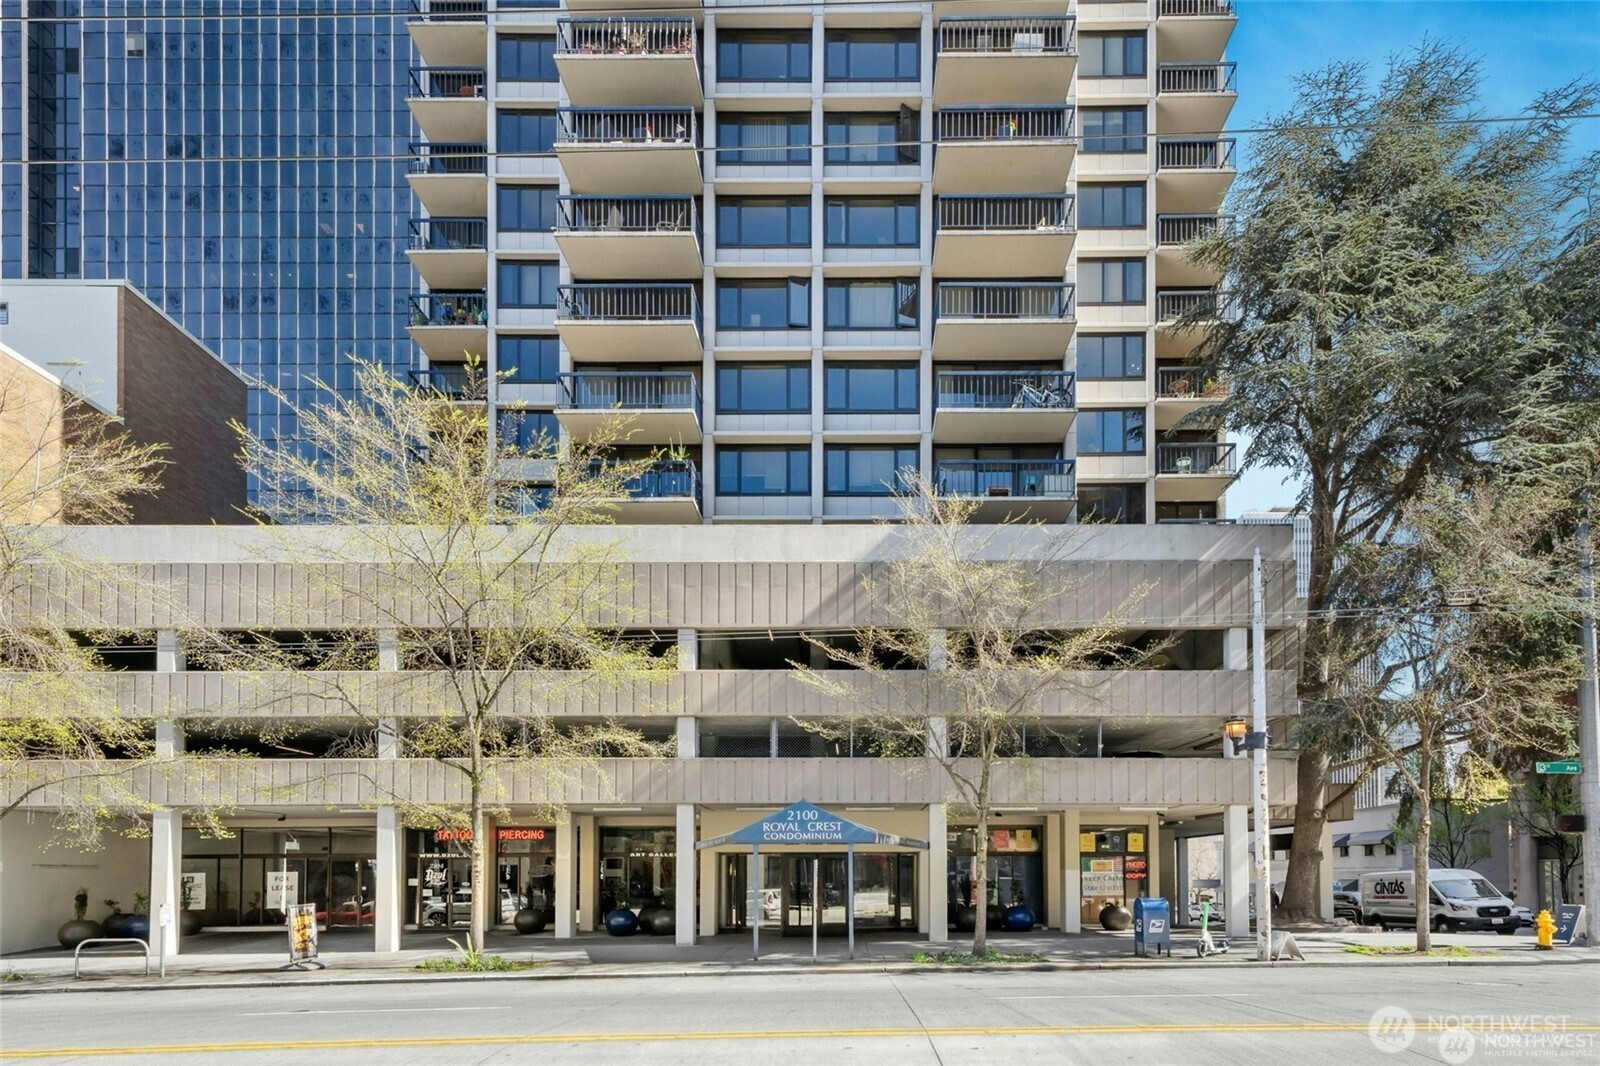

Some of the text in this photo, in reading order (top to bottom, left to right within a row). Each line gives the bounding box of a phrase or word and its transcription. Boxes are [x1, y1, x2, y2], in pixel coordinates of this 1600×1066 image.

[787, 810, 818, 820] 2100
[763, 821, 843, 831] ROYAL CREST
[499, 830, 545, 840] PIERCING
[763, 832, 842, 840] CONDOMINIUM
[1125, 861, 1146, 869] PHOTO
